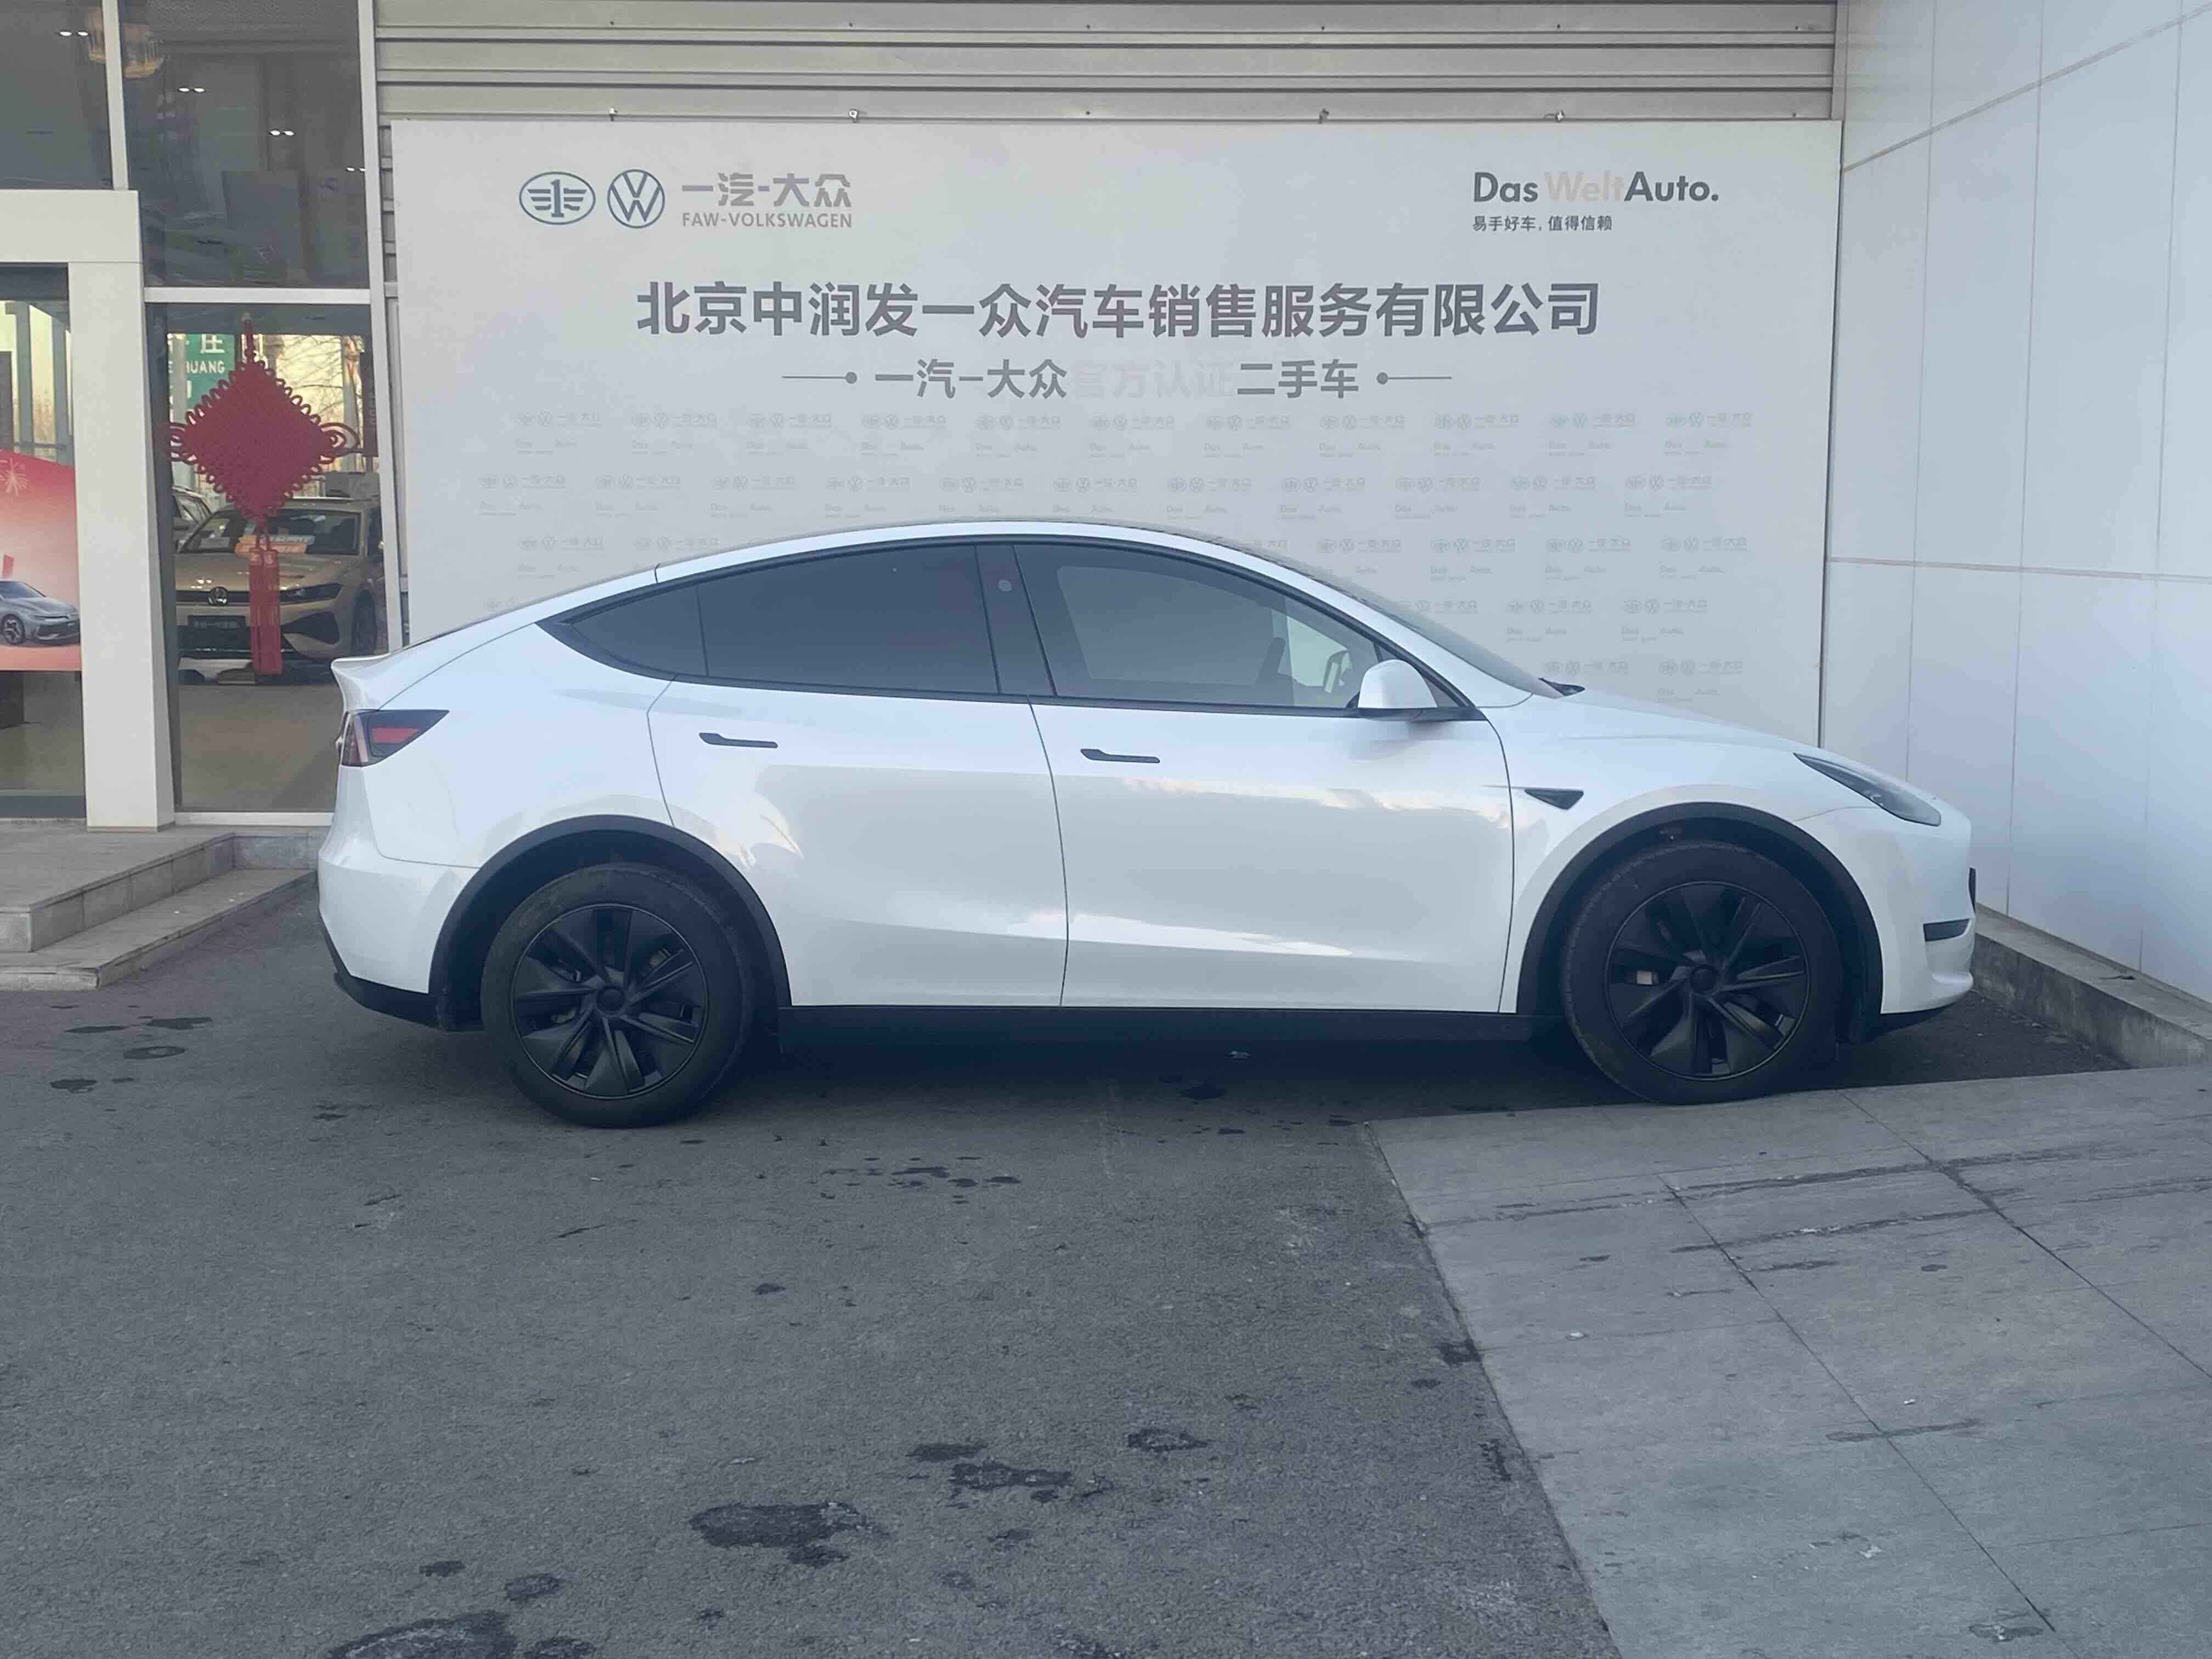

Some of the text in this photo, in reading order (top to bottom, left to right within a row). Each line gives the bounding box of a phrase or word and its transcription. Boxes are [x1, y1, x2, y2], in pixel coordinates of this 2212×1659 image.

[682, 212, 853, 229] FAW-VOLKSWAGEN
[637, 280, 1599, 338] 北京中润发一众汽车销售服务有限公司
